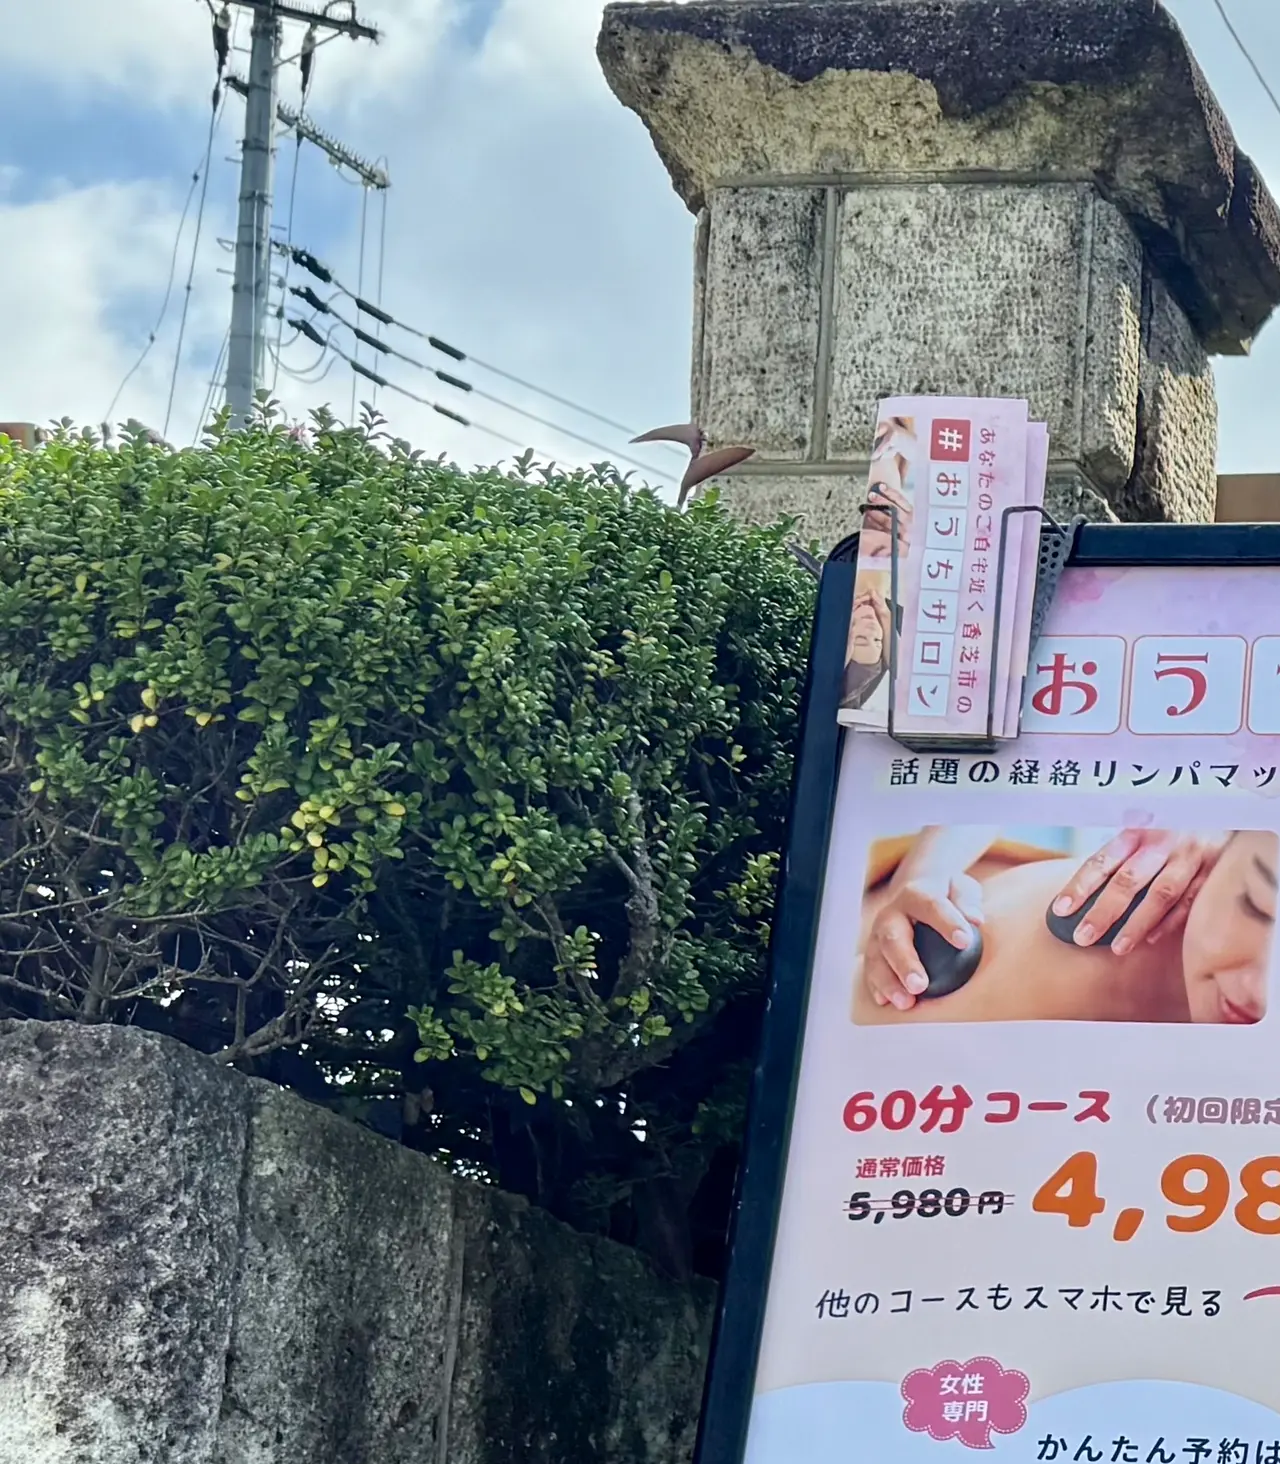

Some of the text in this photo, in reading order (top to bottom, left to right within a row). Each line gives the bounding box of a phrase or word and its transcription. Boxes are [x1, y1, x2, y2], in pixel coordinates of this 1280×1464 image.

[916, 427, 964, 709] #おうちサロン
[956, 427, 997, 715] あなたのご自宅近く香芝市の
[842, 1085, 1111, 1134] 60分コース
[855, 1155, 945, 1178] 通常価格
[848, 1187, 1004, 1225] 5,980円
[815, 1283, 1223, 1320] 他のコースもスマホで見る
[939, 1374, 985, 1396] 女性
[941, 1401, 988, 1423] 専門
